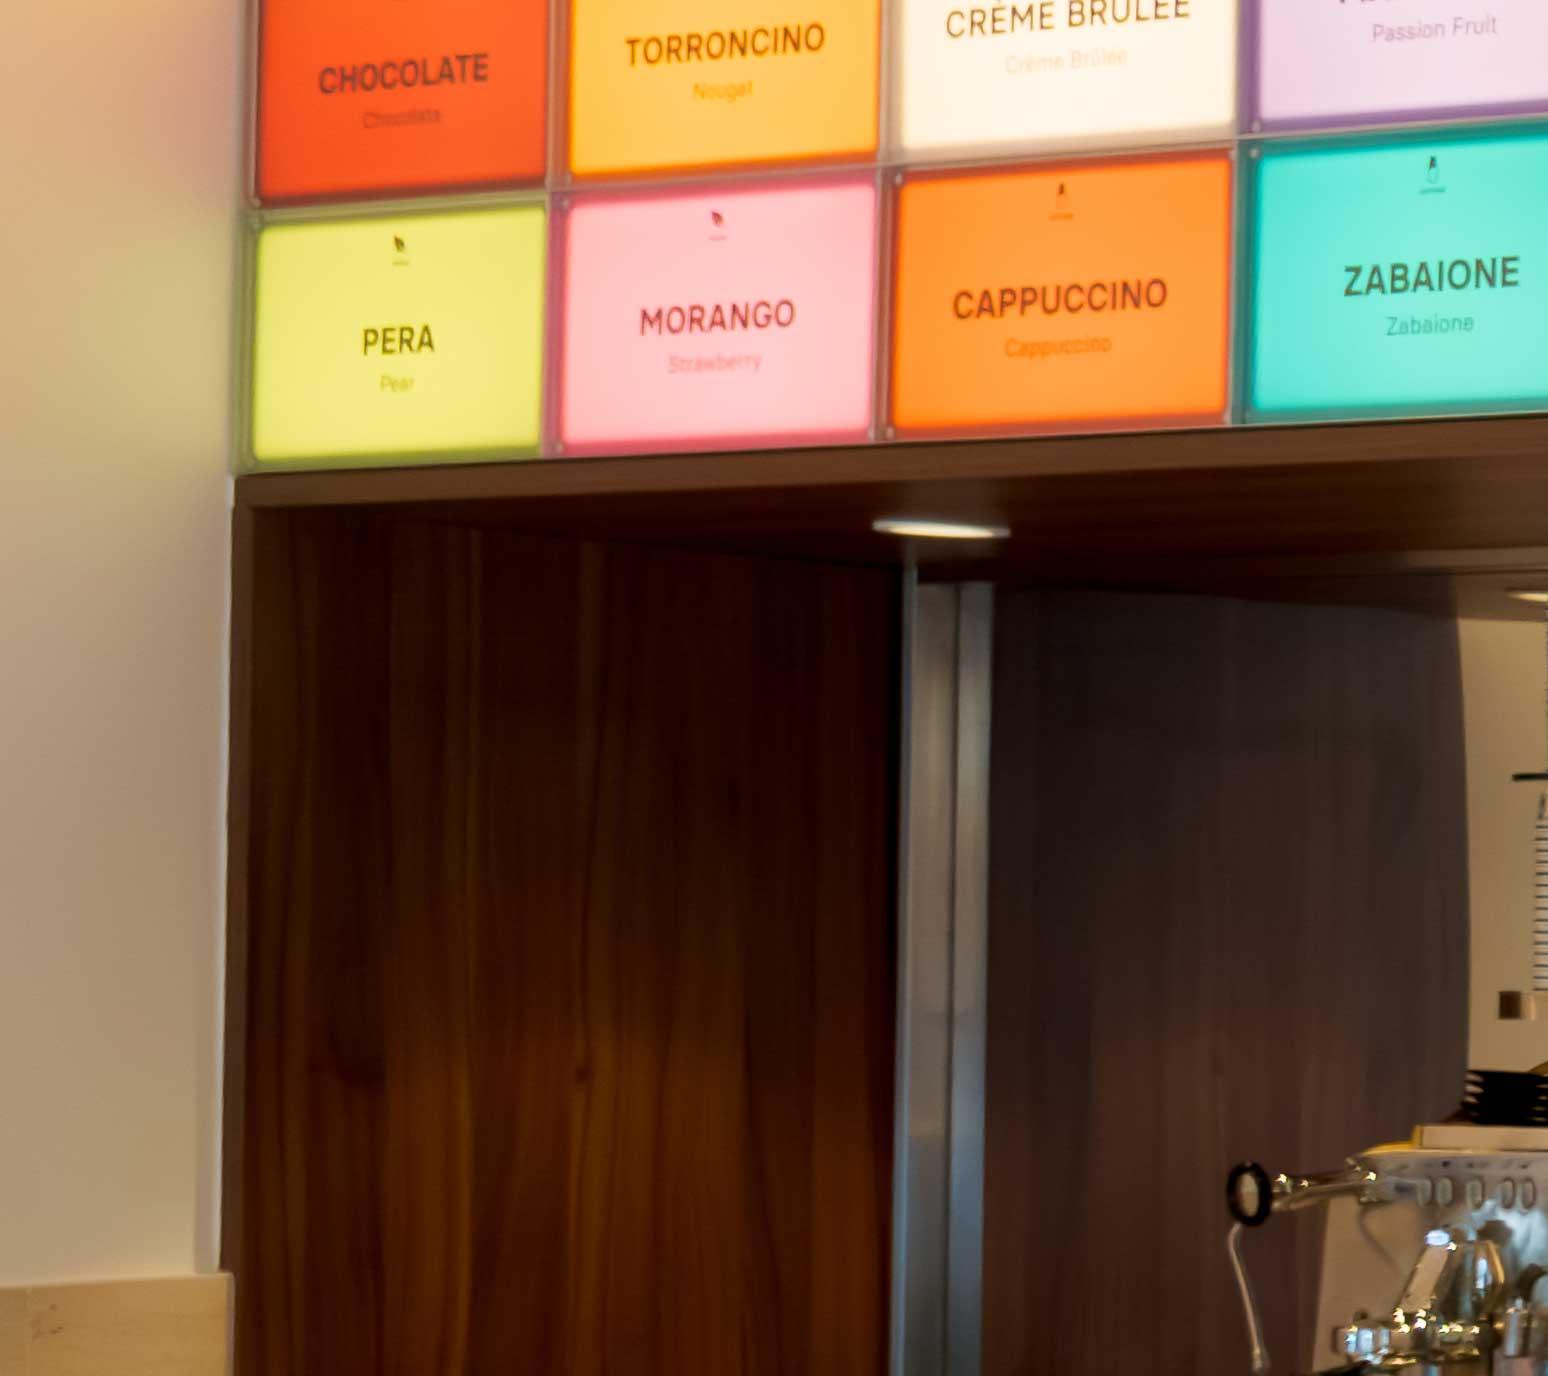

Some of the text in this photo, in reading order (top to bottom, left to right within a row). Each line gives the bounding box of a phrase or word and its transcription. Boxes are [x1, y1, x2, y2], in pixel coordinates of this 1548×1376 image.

[626, 23, 824, 65] TORRONCINO
[1371, 16, 1496, 42] Passion Fruit
[318, 53, 488, 95] CHOCOLATE
[1344, 256, 1518, 296] ZABAIONE
[953, 278, 1167, 319] CAPPUCCINO
[640, 300, 794, 336] MORANGO
[1386, 314, 1474, 336] Zabaione
[362, 325, 434, 355] PERA
[1004, 334, 1112, 360] Cappuccino
